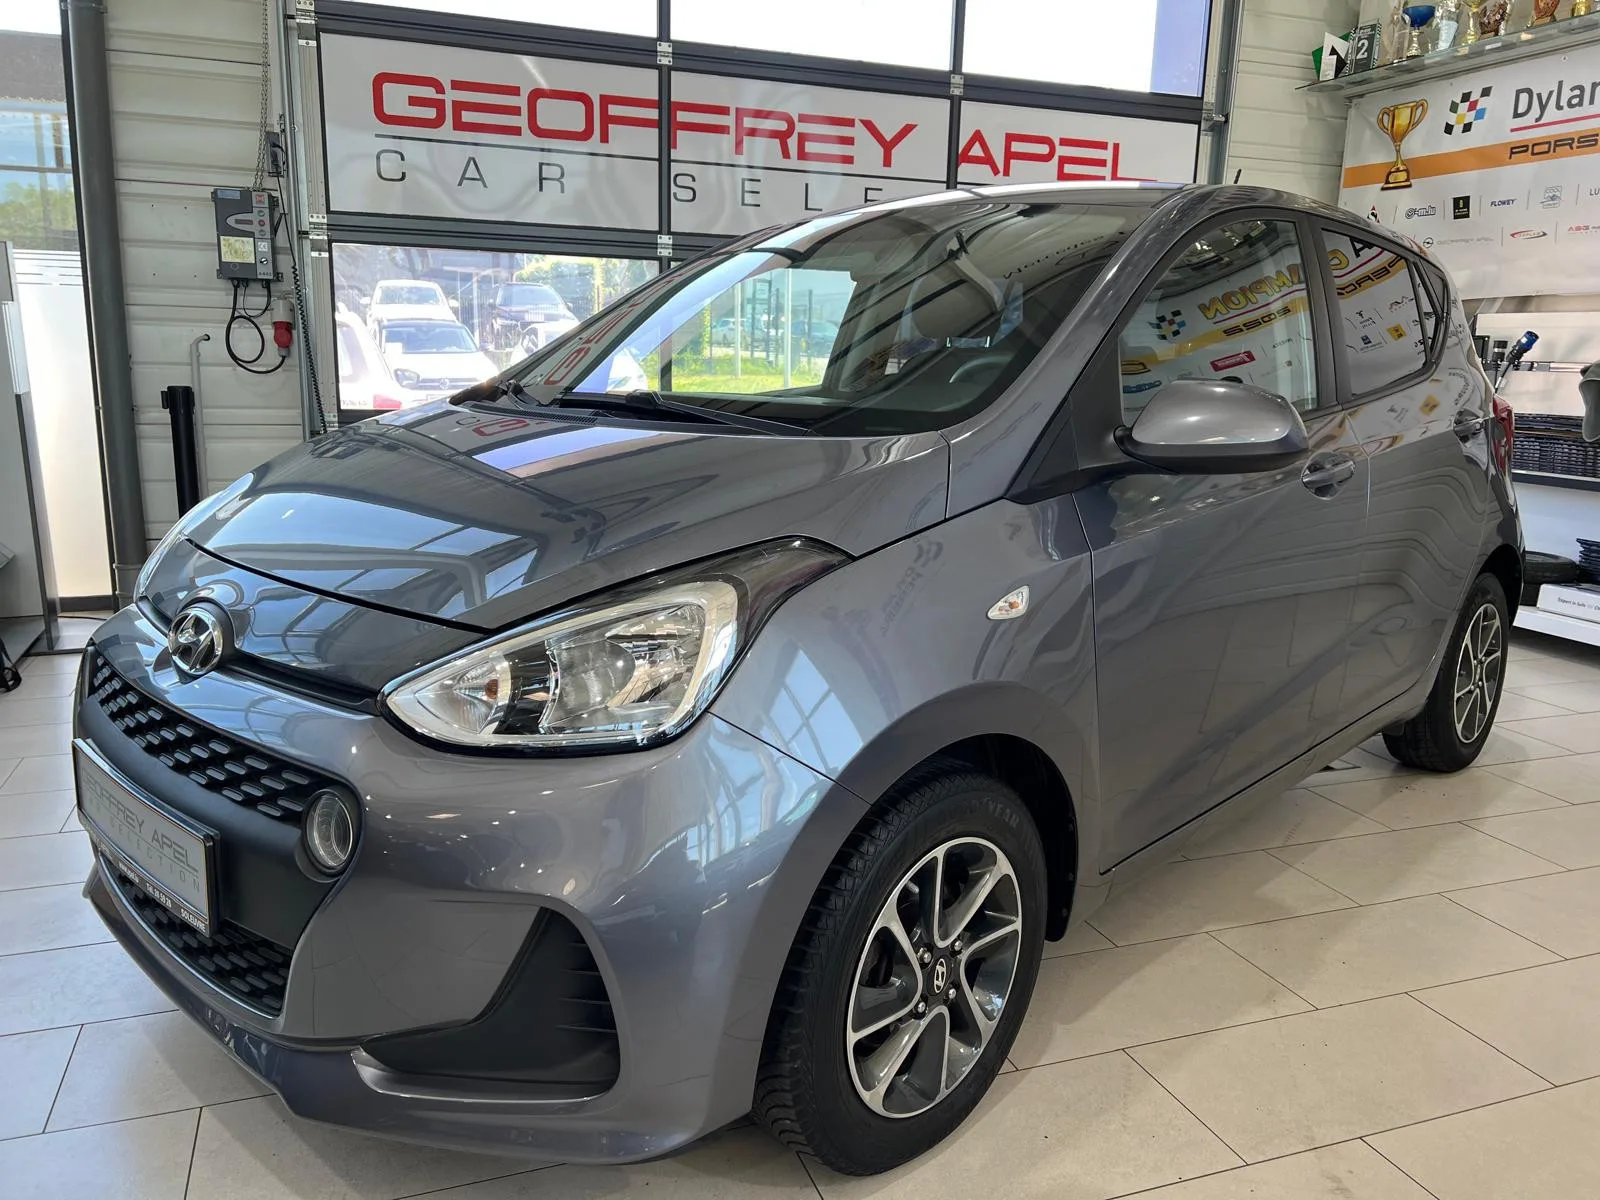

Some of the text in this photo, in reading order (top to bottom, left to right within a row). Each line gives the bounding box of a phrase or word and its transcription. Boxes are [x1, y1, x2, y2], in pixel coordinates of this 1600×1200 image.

[1356, 38, 1369, 59] 2
[372, 71, 1159, 182] GEOFFREY APEL
[375, 148, 566, 194] CAR
[151, 828, 200, 874] APEL
